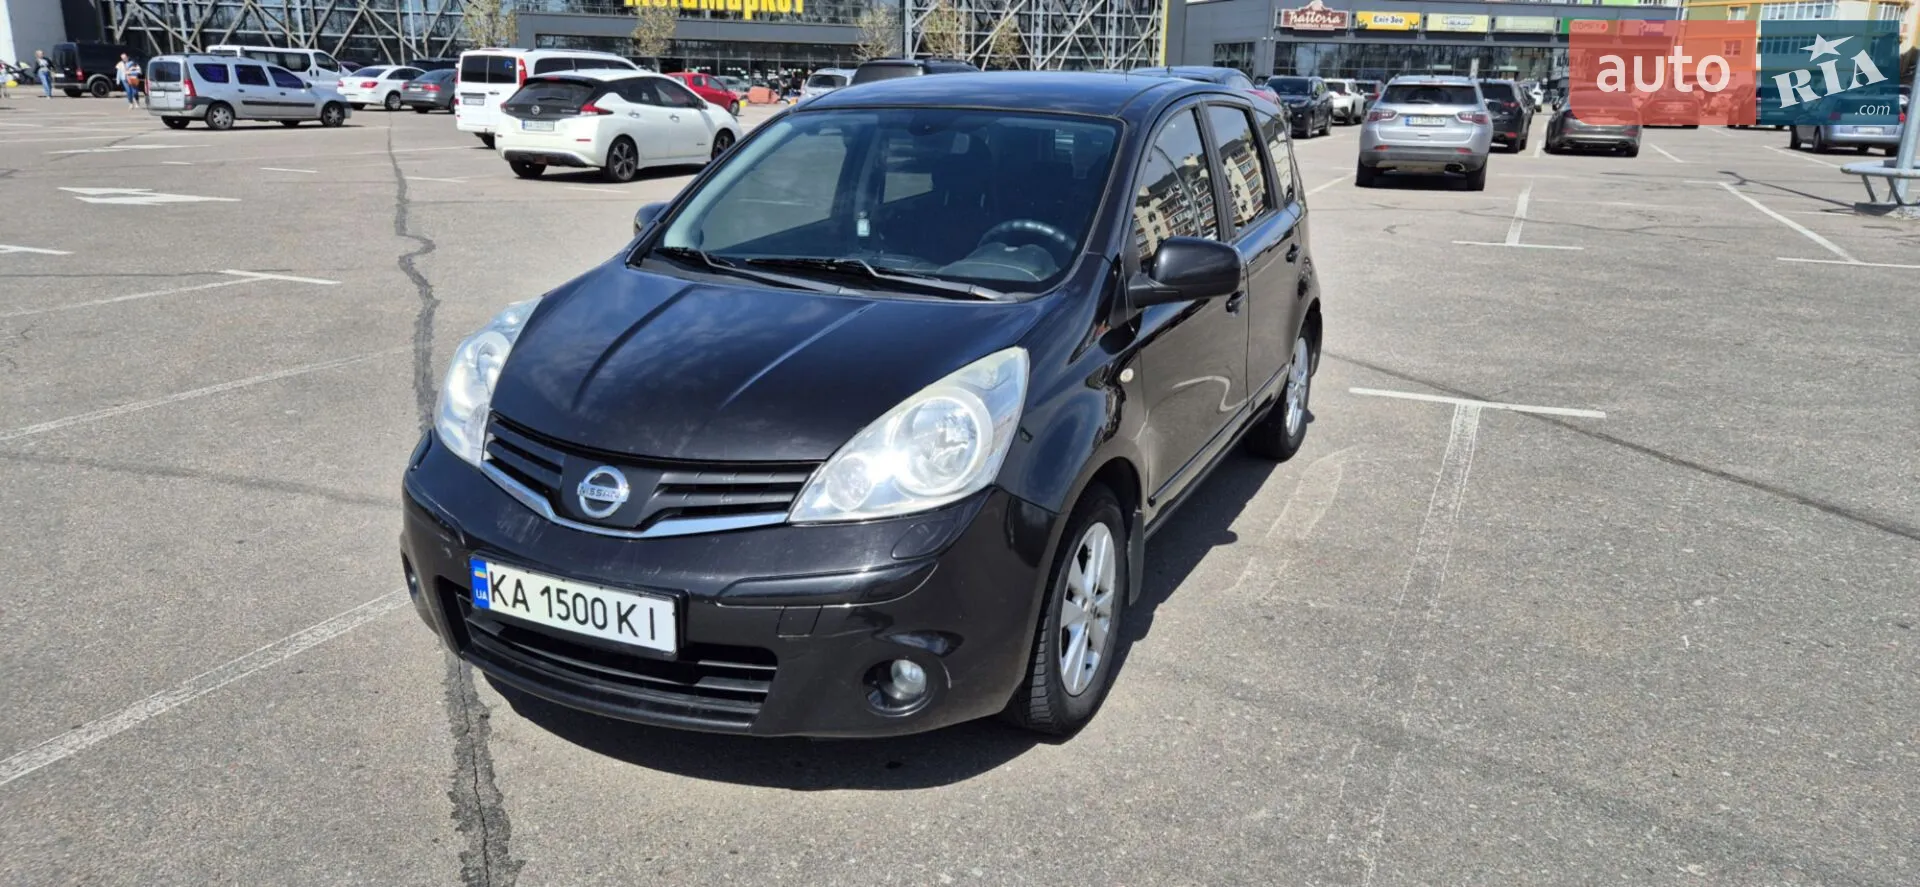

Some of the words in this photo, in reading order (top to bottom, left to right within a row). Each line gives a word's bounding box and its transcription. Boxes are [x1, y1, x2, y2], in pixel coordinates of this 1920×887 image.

[475, 589, 488, 600] UA
[489, 571, 530, 612] KA
[540, 585, 607, 630] 1500
[617, 601, 655, 640] KI
